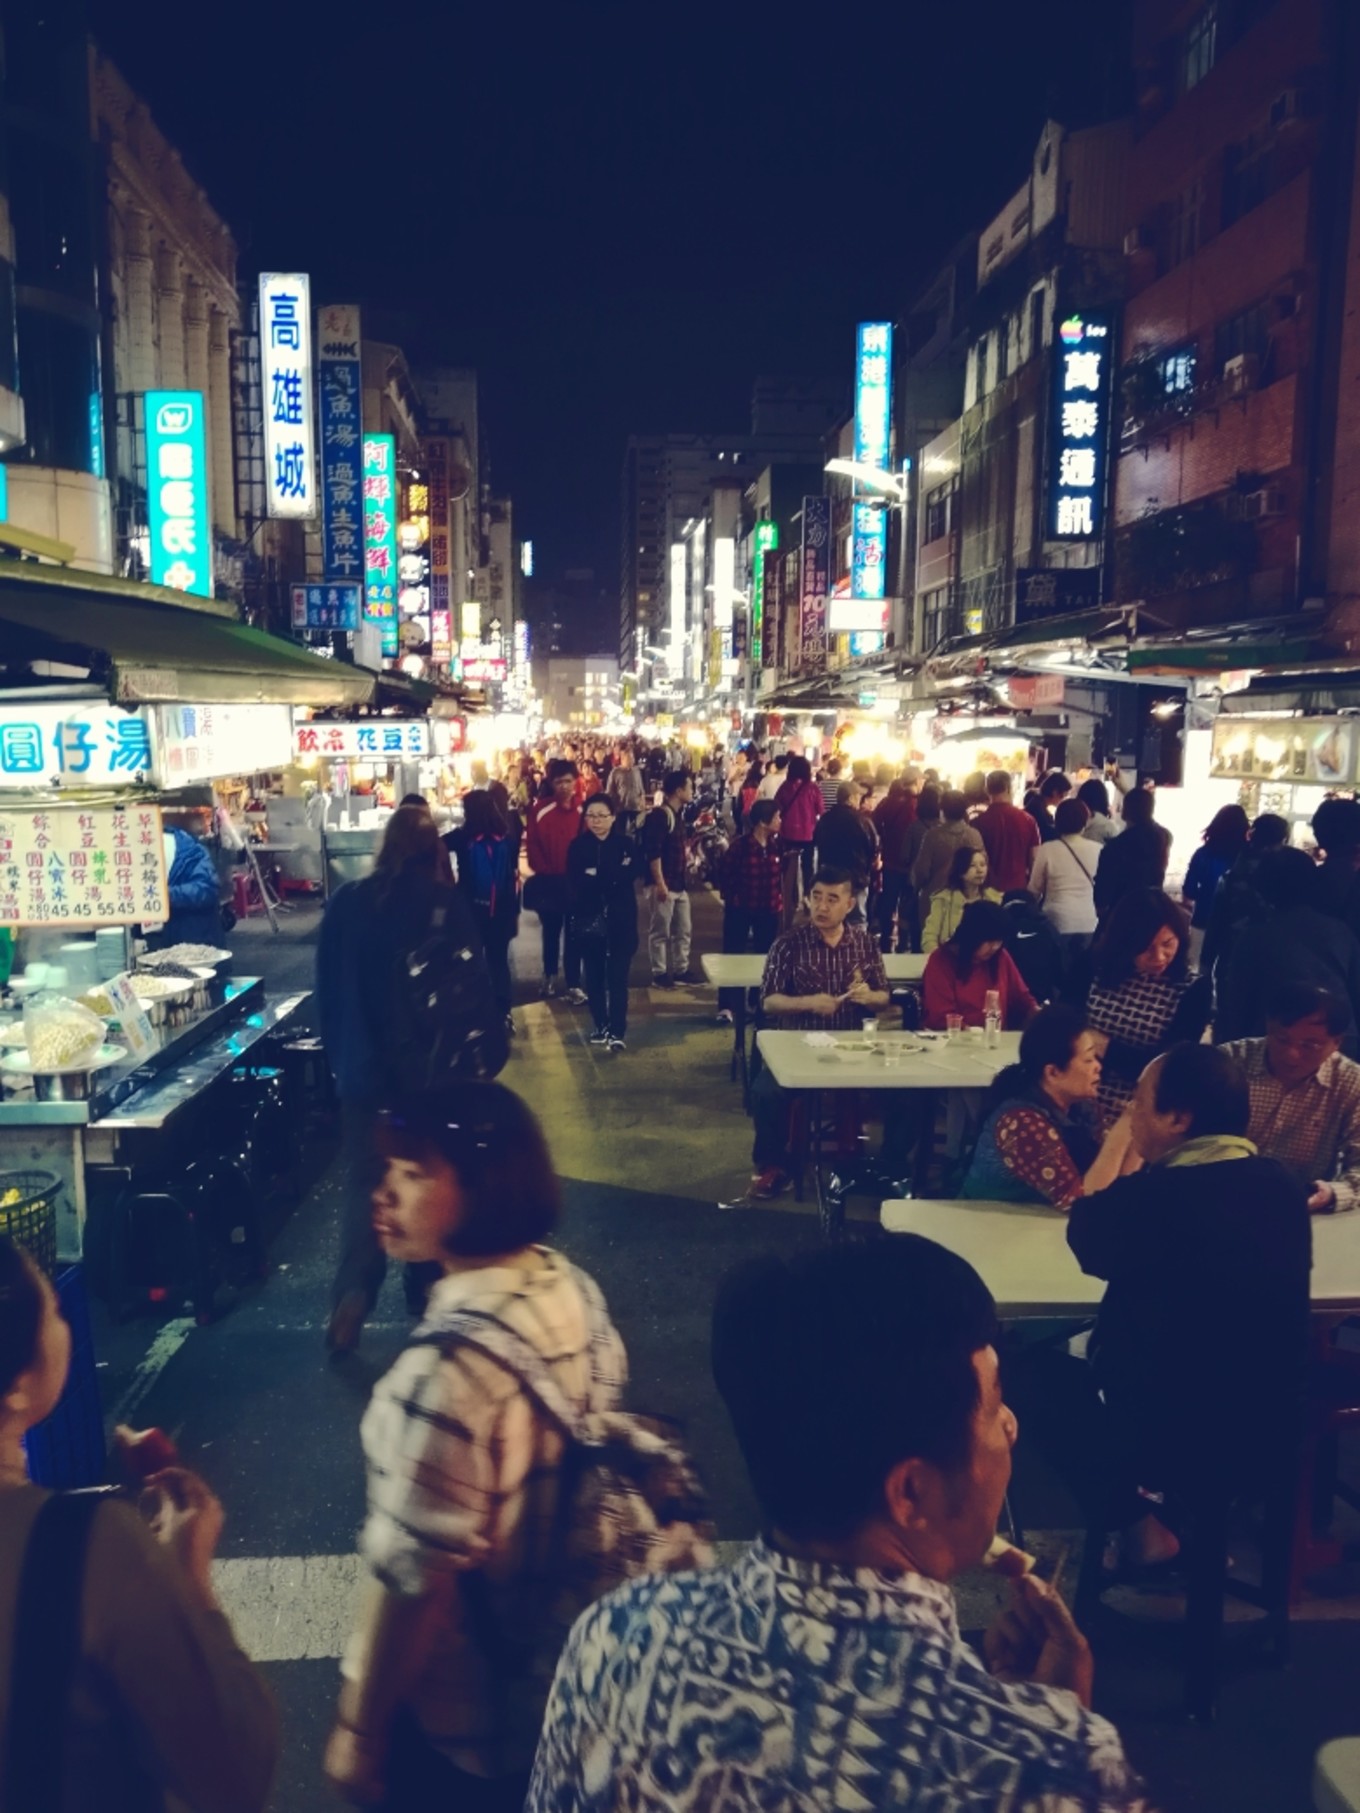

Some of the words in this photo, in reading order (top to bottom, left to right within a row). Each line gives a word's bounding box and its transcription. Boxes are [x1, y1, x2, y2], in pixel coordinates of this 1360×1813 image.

[270, 293, 307, 500] 高雄城
[1058, 352, 1101, 534] 萬泰通訊
[364, 439, 391, 578] 阿輝海鮮
[0, 719, 152, 773] 圓仔湯
